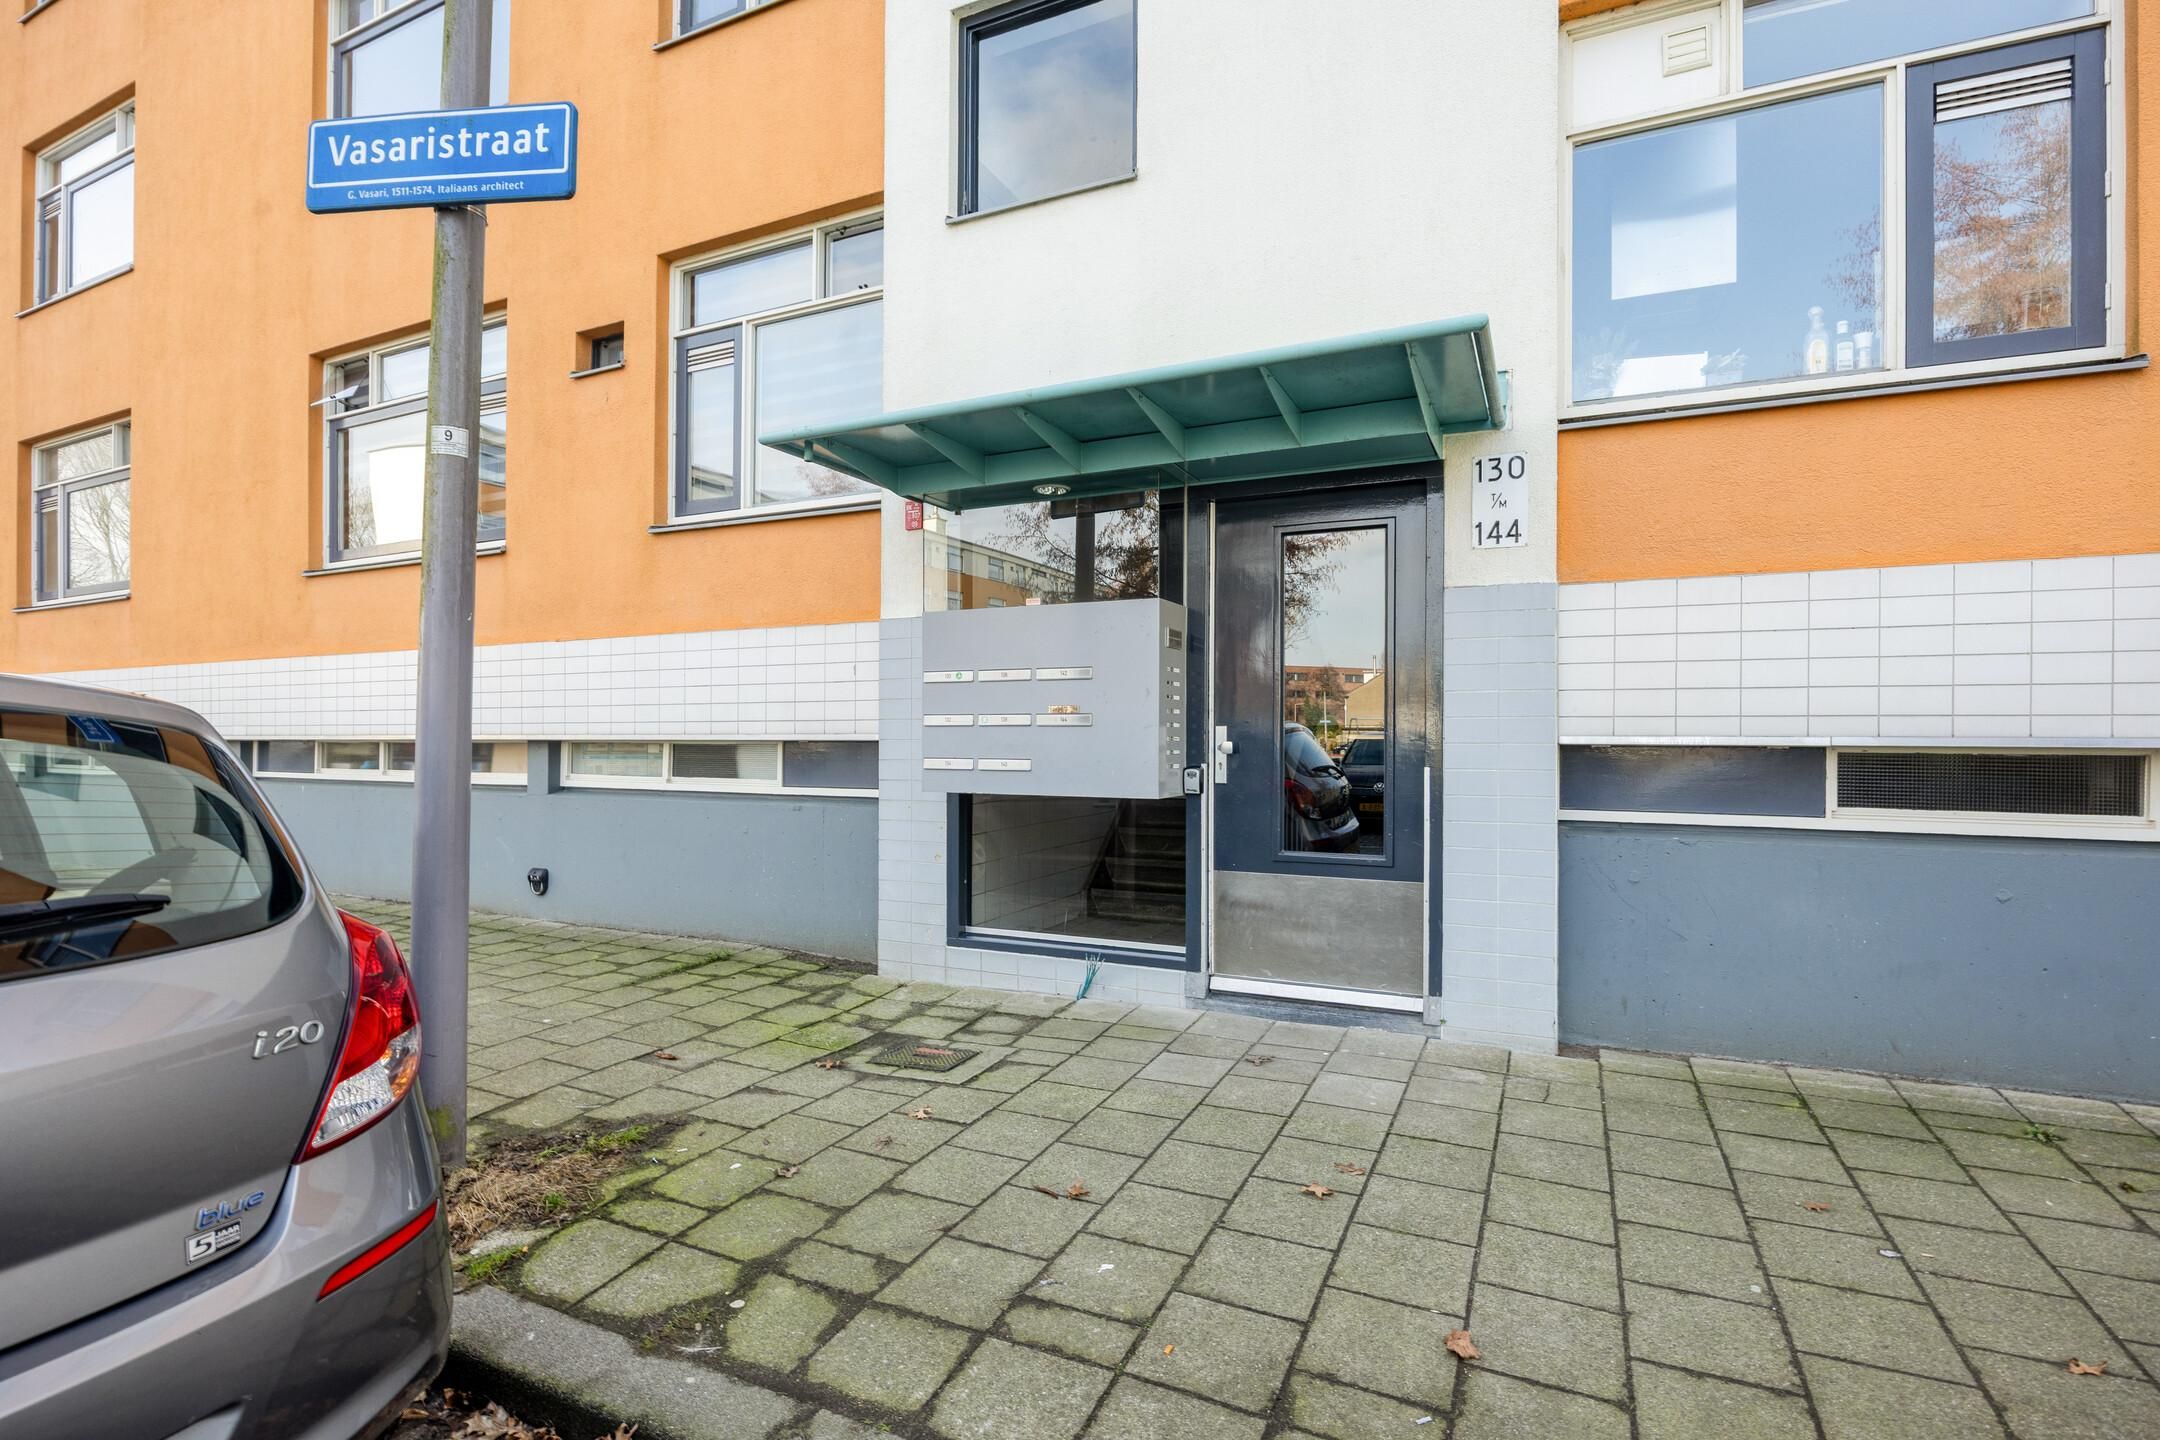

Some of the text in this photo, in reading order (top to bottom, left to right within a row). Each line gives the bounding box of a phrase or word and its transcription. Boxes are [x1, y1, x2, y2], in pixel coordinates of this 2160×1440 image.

[327, 122, 550, 167] Vasaristraat
[347, 181, 525, 200] G. Vasari, 1511-1574, Italiaans architect
[444, 429, 453, 441] 9
[1475, 455, 1525, 483] 130
[1491, 492, 1507, 510] T/M
[1475, 518, 1522, 546] 144
[253, 1020, 324, 1058] i20
[197, 1191, 265, 1230] blue
[193, 1233, 213, 1258] 5
[215, 1224, 240, 1237] JAAR
